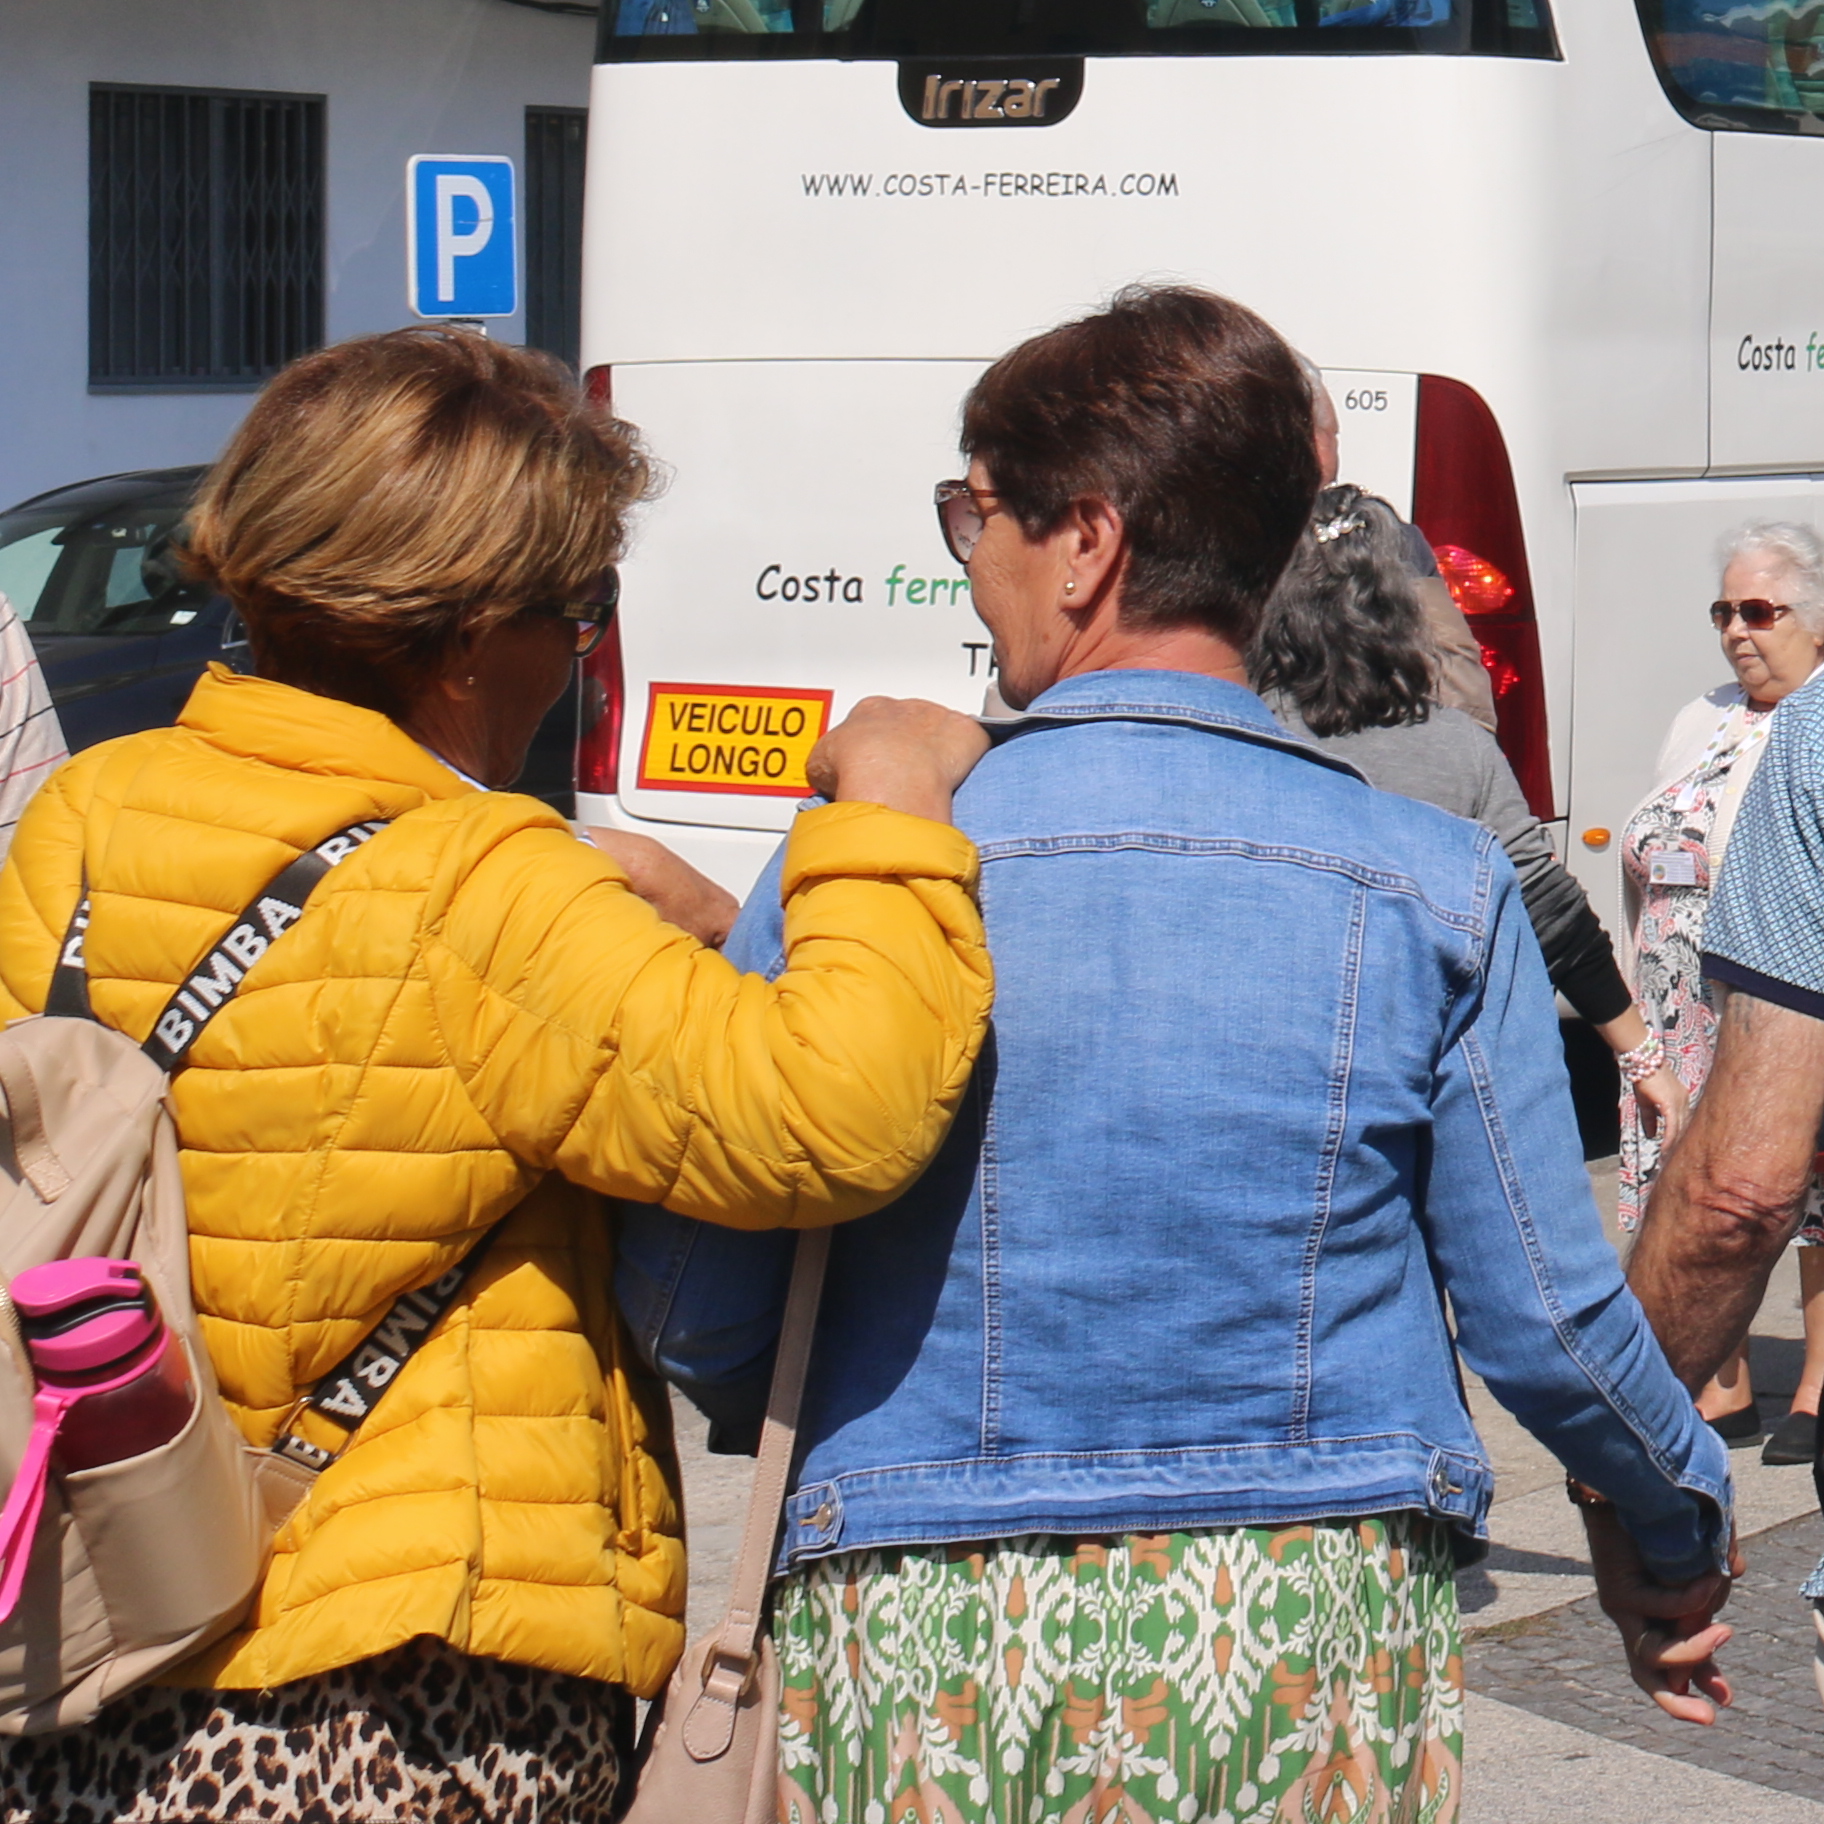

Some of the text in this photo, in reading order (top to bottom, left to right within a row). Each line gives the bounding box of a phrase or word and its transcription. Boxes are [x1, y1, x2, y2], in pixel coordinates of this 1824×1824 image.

[922, 74, 1061, 120] Irizar
[800, 172, 1181, 198] WWW.COSTA-FERREIRA.COM
[436, 174, 494, 302] P
[1737, 333, 1796, 372] Costa
[1344, 388, 1389, 412] 605
[756, 563, 864, 604] Costa
[669, 701, 806, 738] VEICULO
[669, 742, 788, 779] LONGO
[154, 895, 304, 1055] BIMBA
